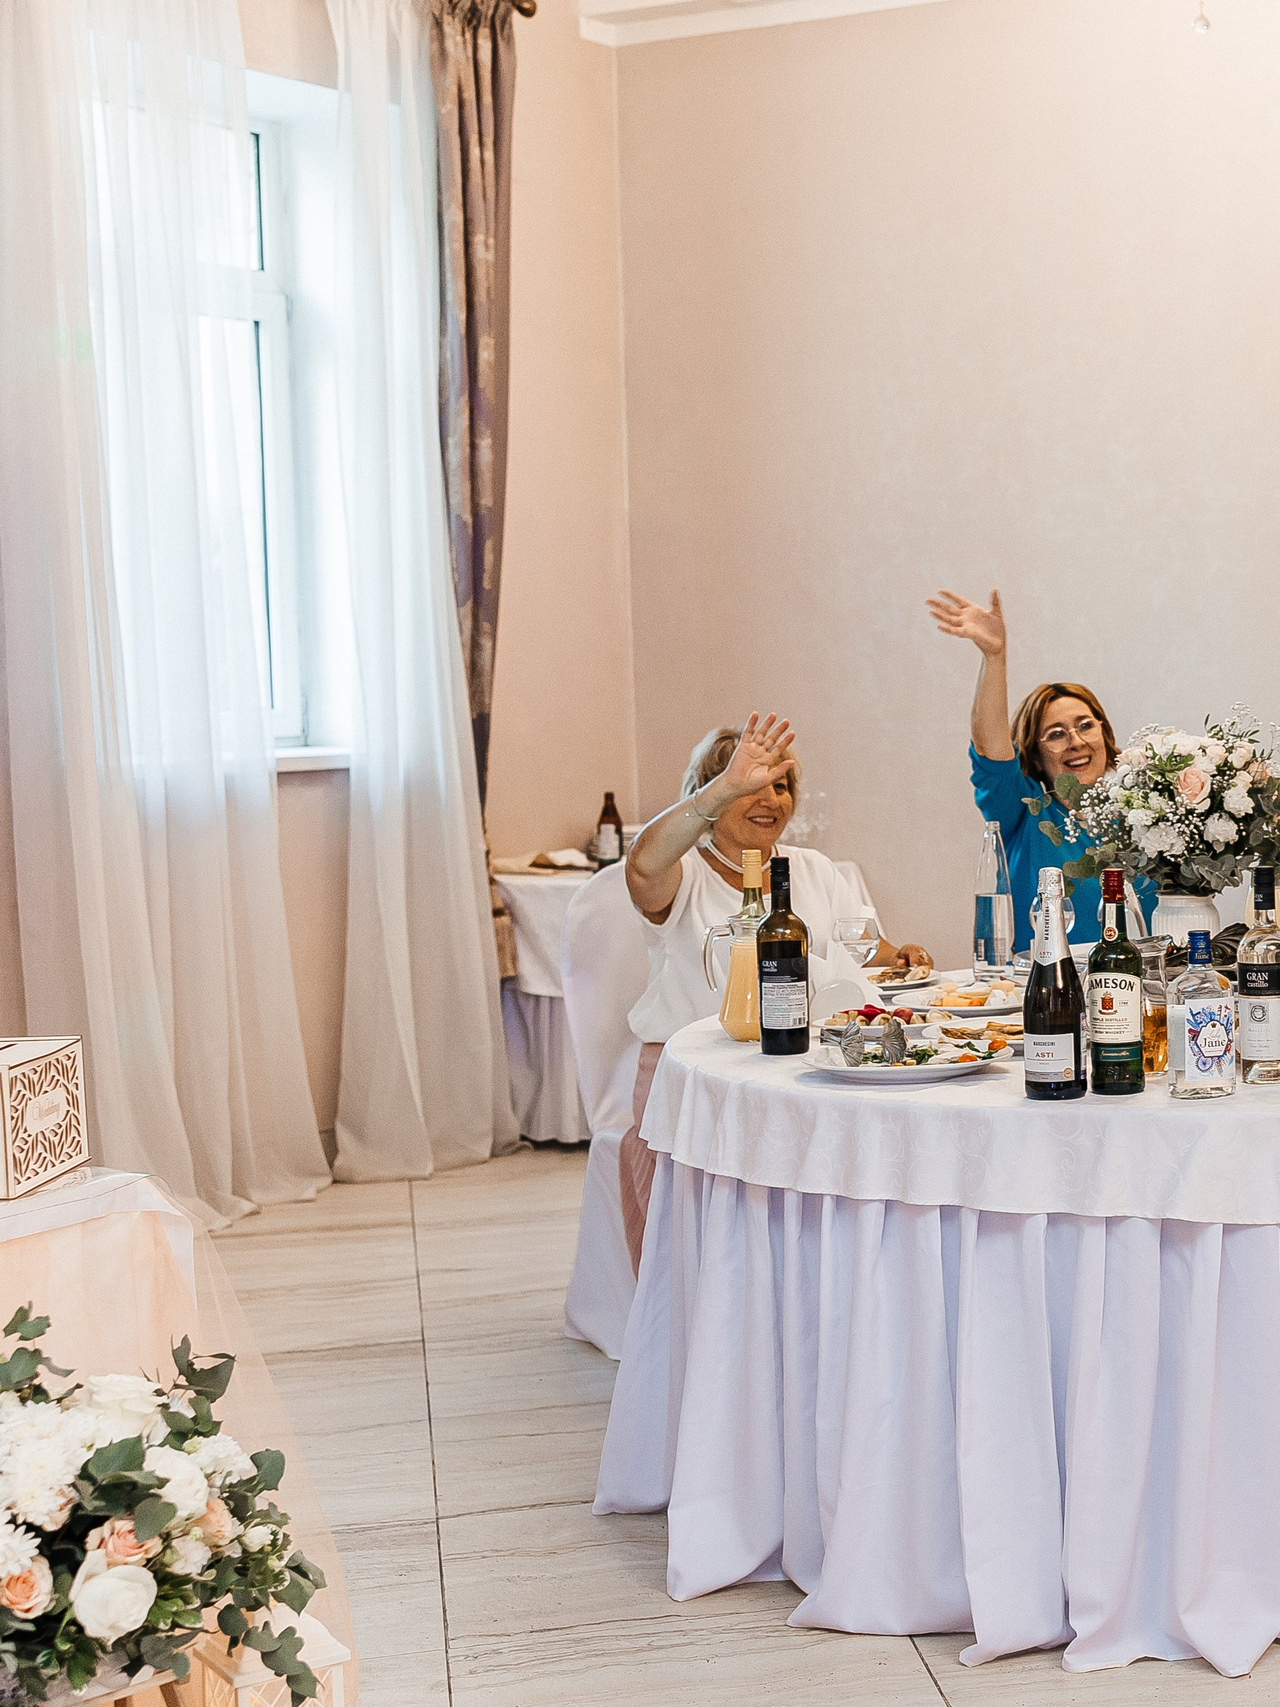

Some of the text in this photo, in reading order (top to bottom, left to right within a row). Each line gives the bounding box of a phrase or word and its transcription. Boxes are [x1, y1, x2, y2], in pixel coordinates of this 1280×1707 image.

[1246, 972, 1269, 981] GRAN
[1089, 978, 1136, 992] AMESON
[1200, 1037, 1226, 1048] Jane
